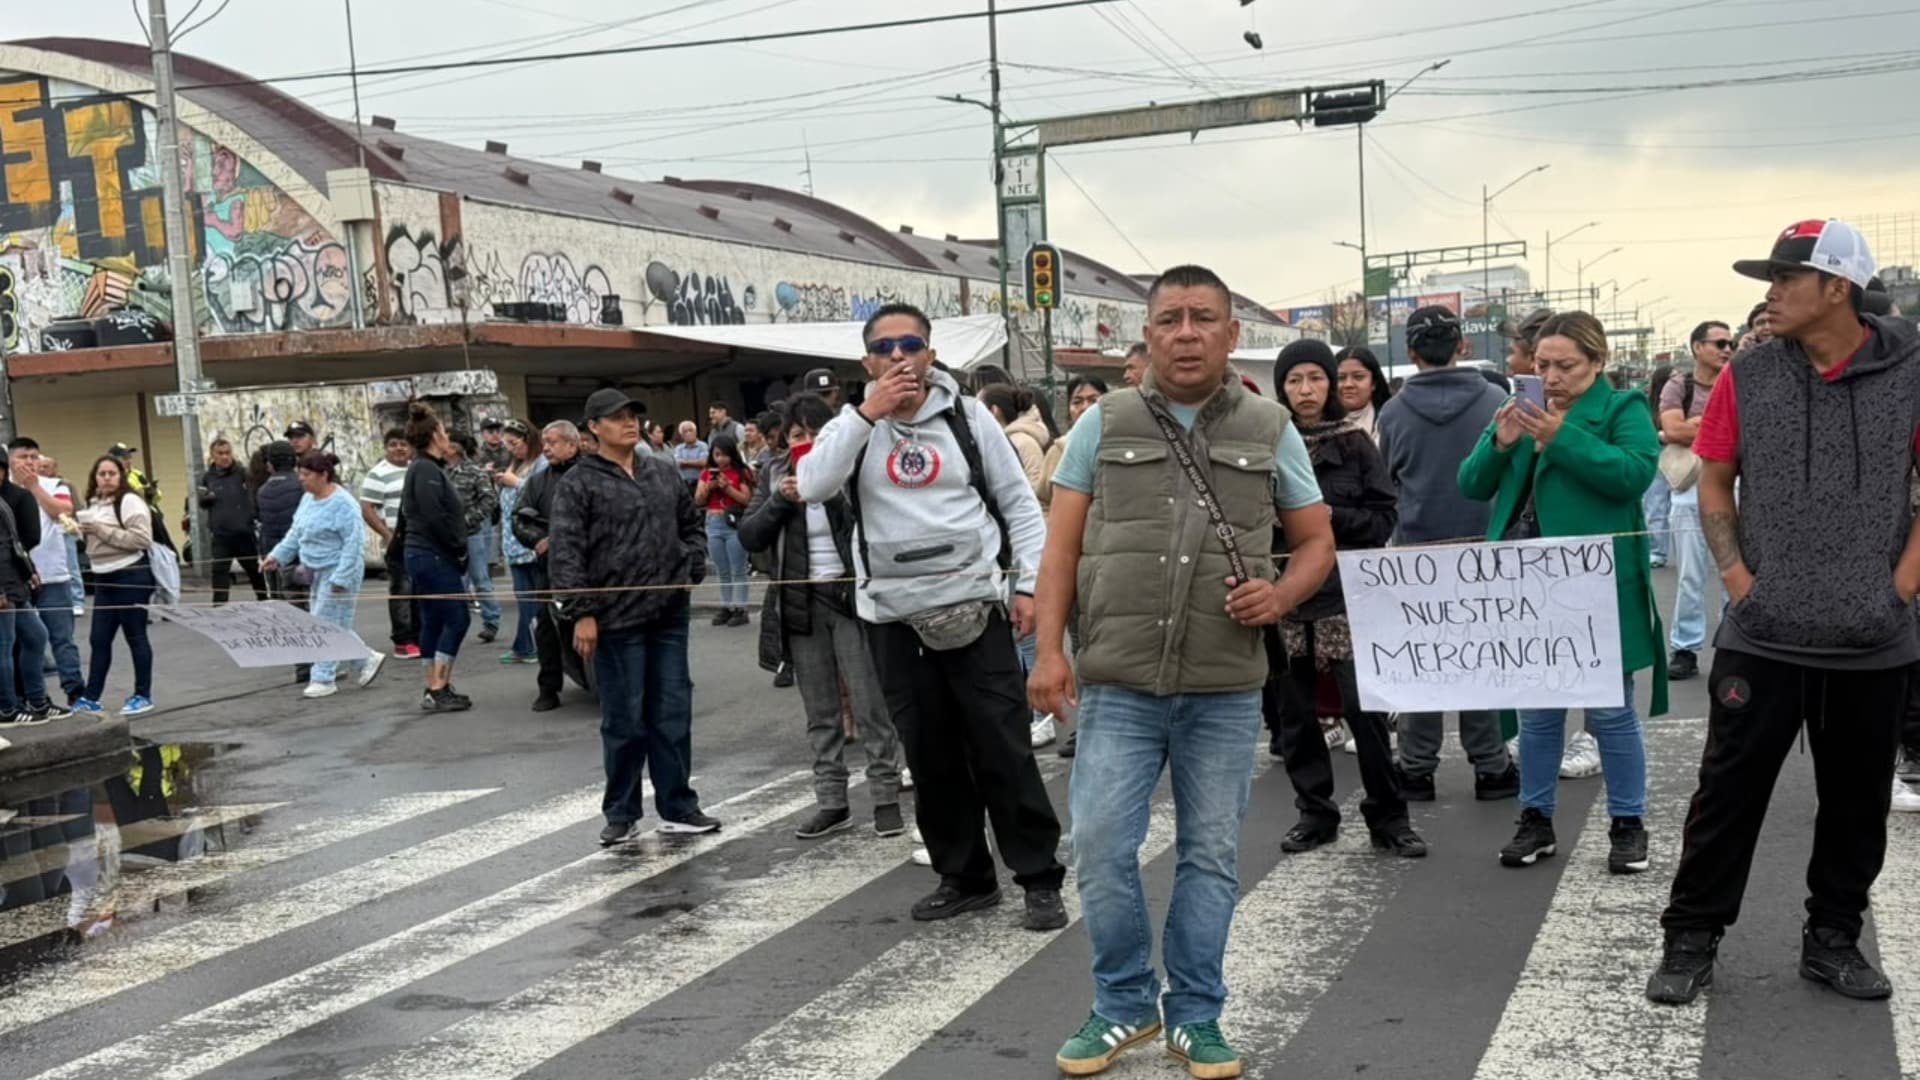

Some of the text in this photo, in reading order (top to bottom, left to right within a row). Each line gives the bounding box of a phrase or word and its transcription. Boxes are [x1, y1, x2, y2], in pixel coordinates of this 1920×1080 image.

[1007, 184, 1032, 195] NTE
[1016, 169, 1022, 183] 1
[1173, 440, 1191, 465] HUGO
[1188, 466, 1206, 492] HUGO
[1203, 492, 1221, 519] HUGO
[1230, 551, 1245, 579] HUGO
[1360, 542, 1614, 586] SOLO QUEREMOS
[1401, 597, 1539, 626] NUESTRA
